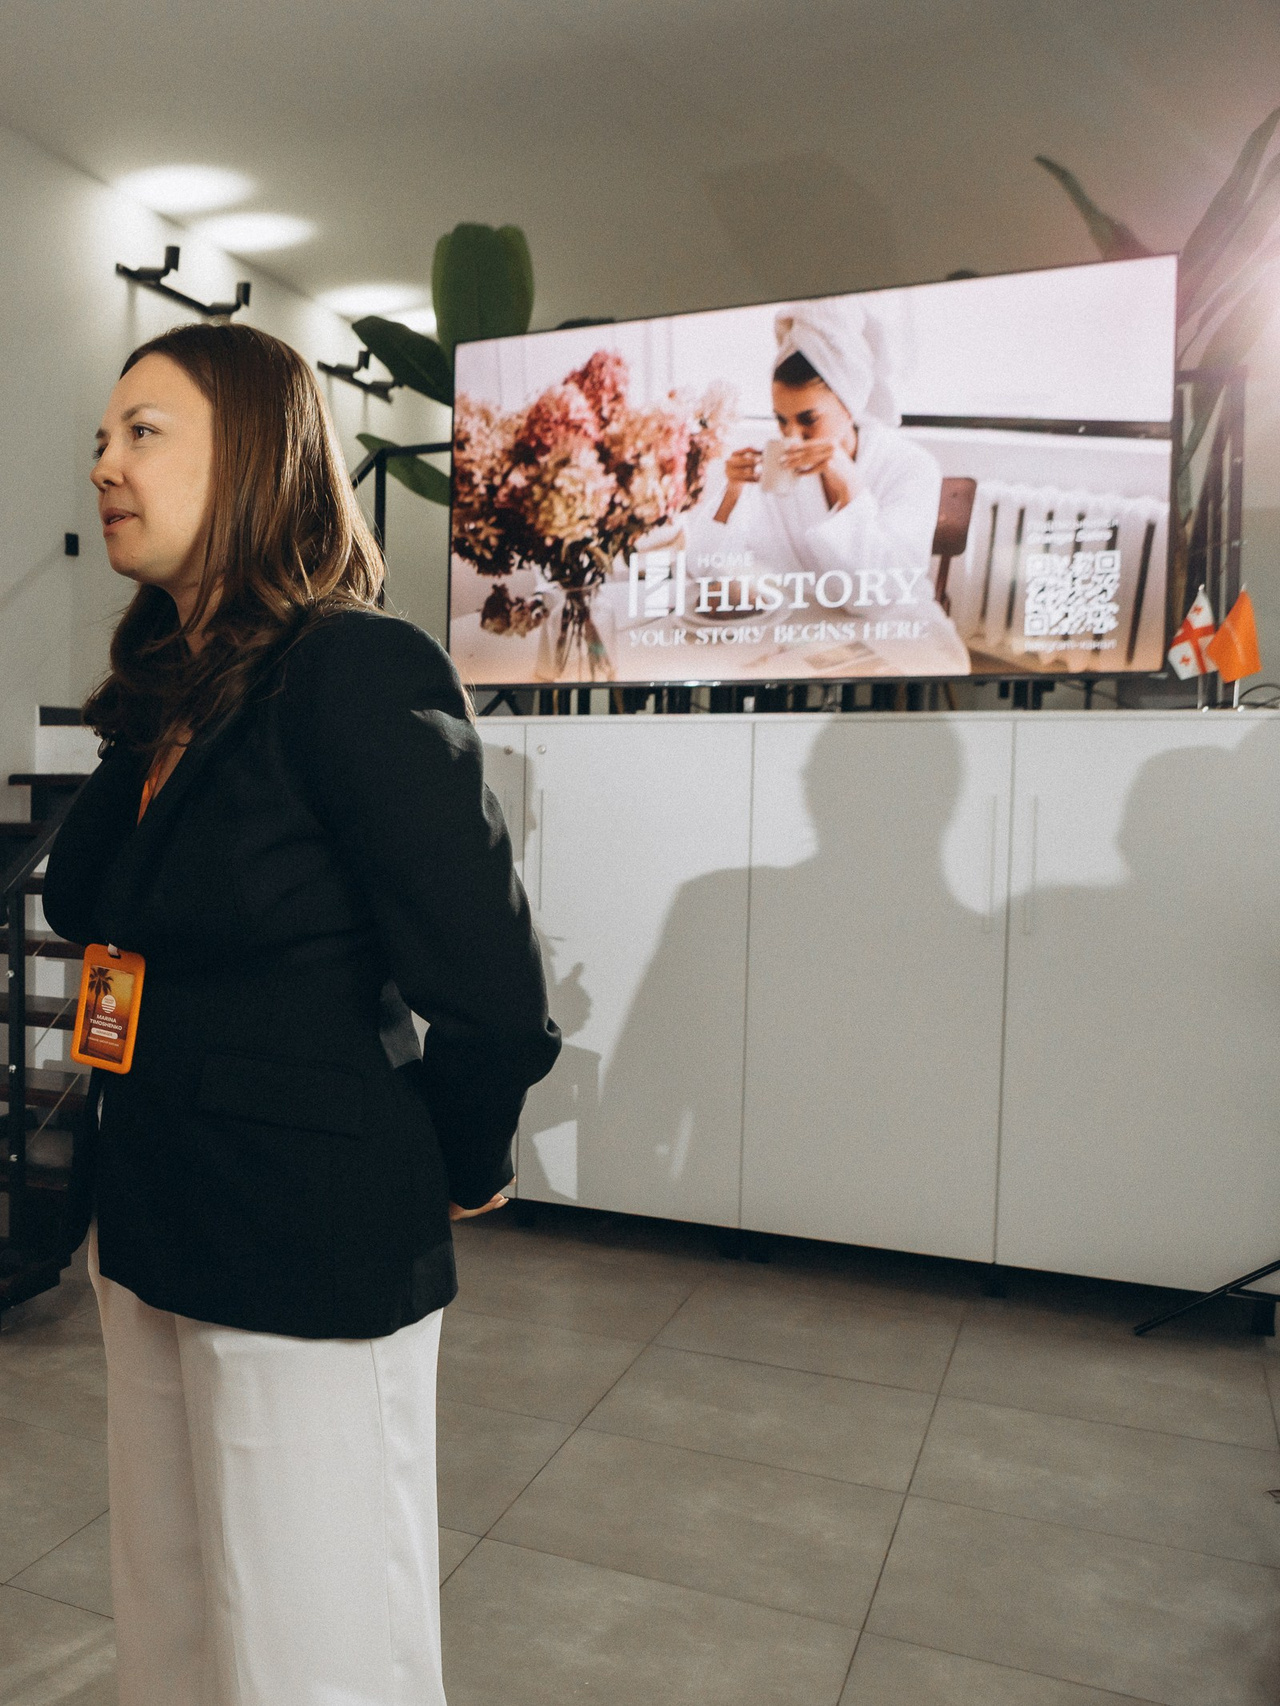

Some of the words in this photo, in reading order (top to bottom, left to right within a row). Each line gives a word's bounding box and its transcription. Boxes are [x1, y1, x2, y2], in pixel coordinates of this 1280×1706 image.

[697, 552, 755, 569] HOME
[695, 568, 926, 613] HISTORY
[628, 627, 688, 648] YOUR
[695, 625, 766, 645] STORY
[863, 620, 929, 641] HERE
[96, 1014, 117, 1023] MARINA
